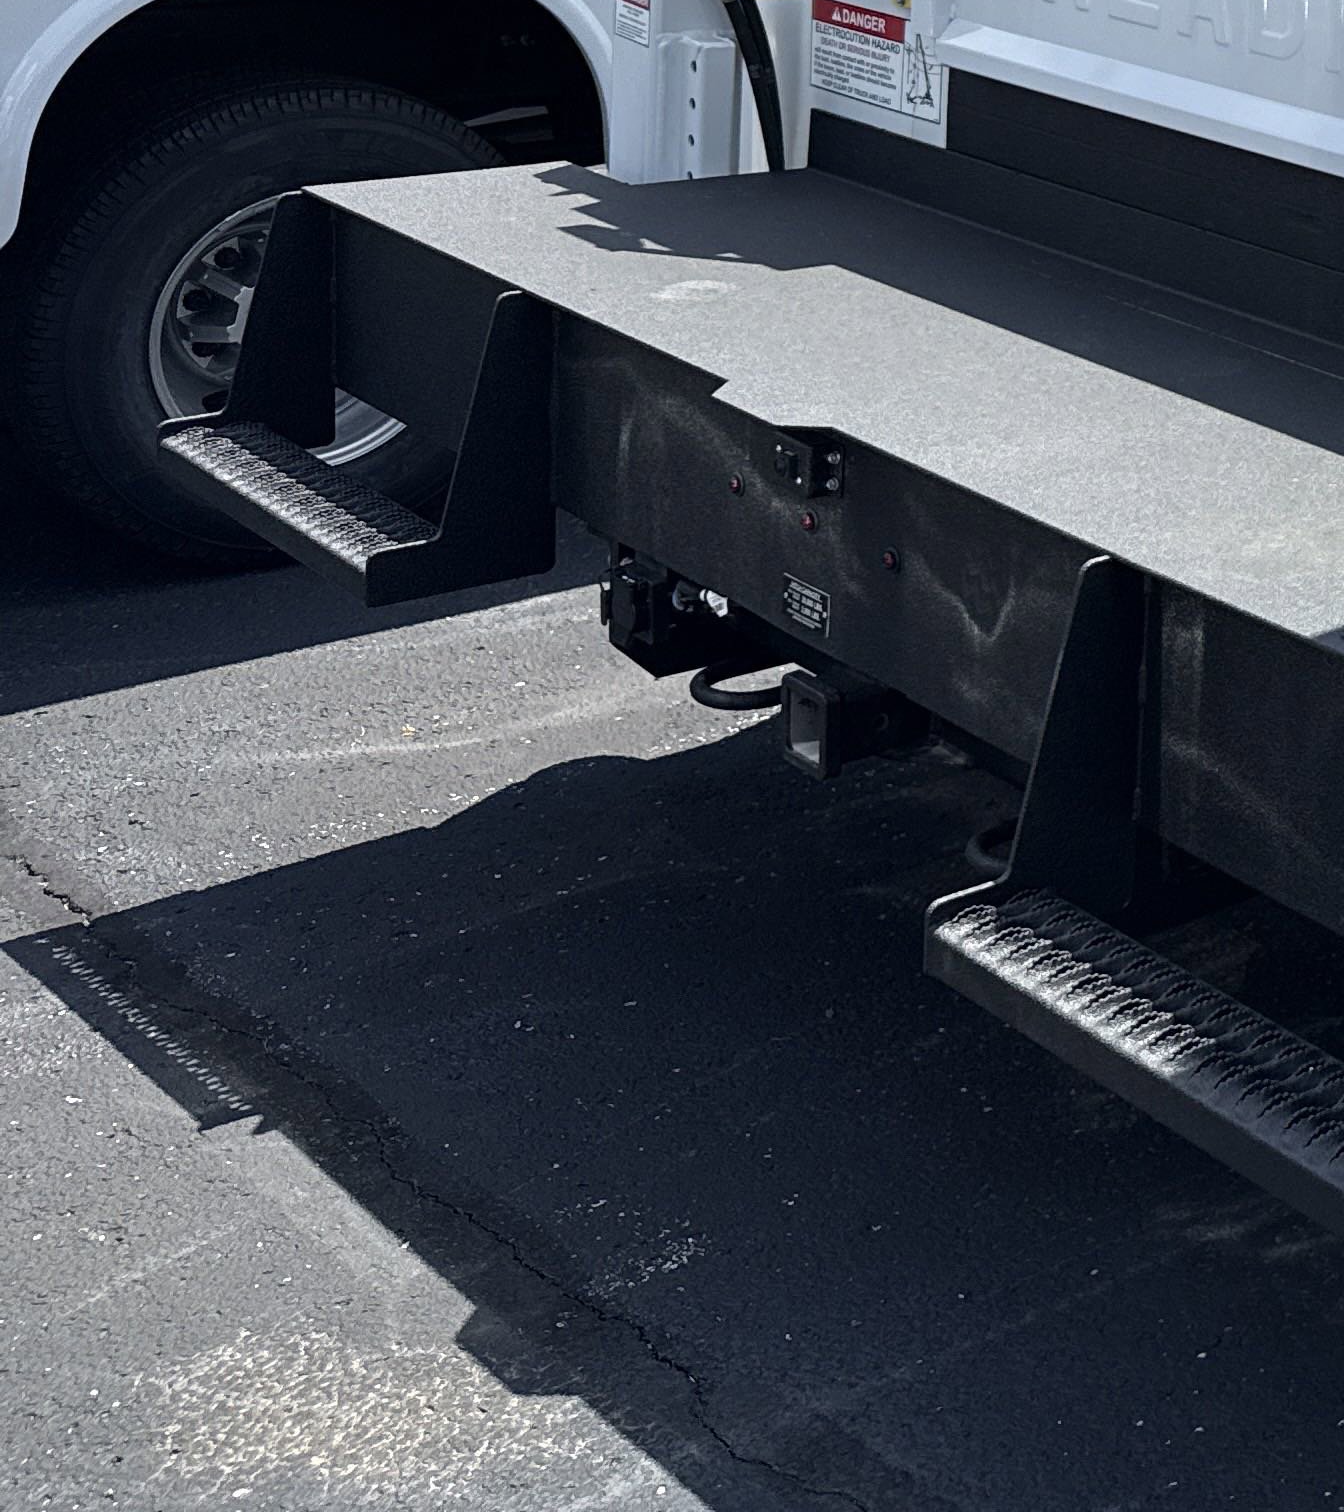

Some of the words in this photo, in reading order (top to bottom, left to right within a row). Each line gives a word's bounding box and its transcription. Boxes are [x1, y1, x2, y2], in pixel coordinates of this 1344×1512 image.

[842, 8, 886, 33] DANGER
[815, 22, 870, 45] ELECTROCUTION
[871, 37, 900, 54] HAZARD
